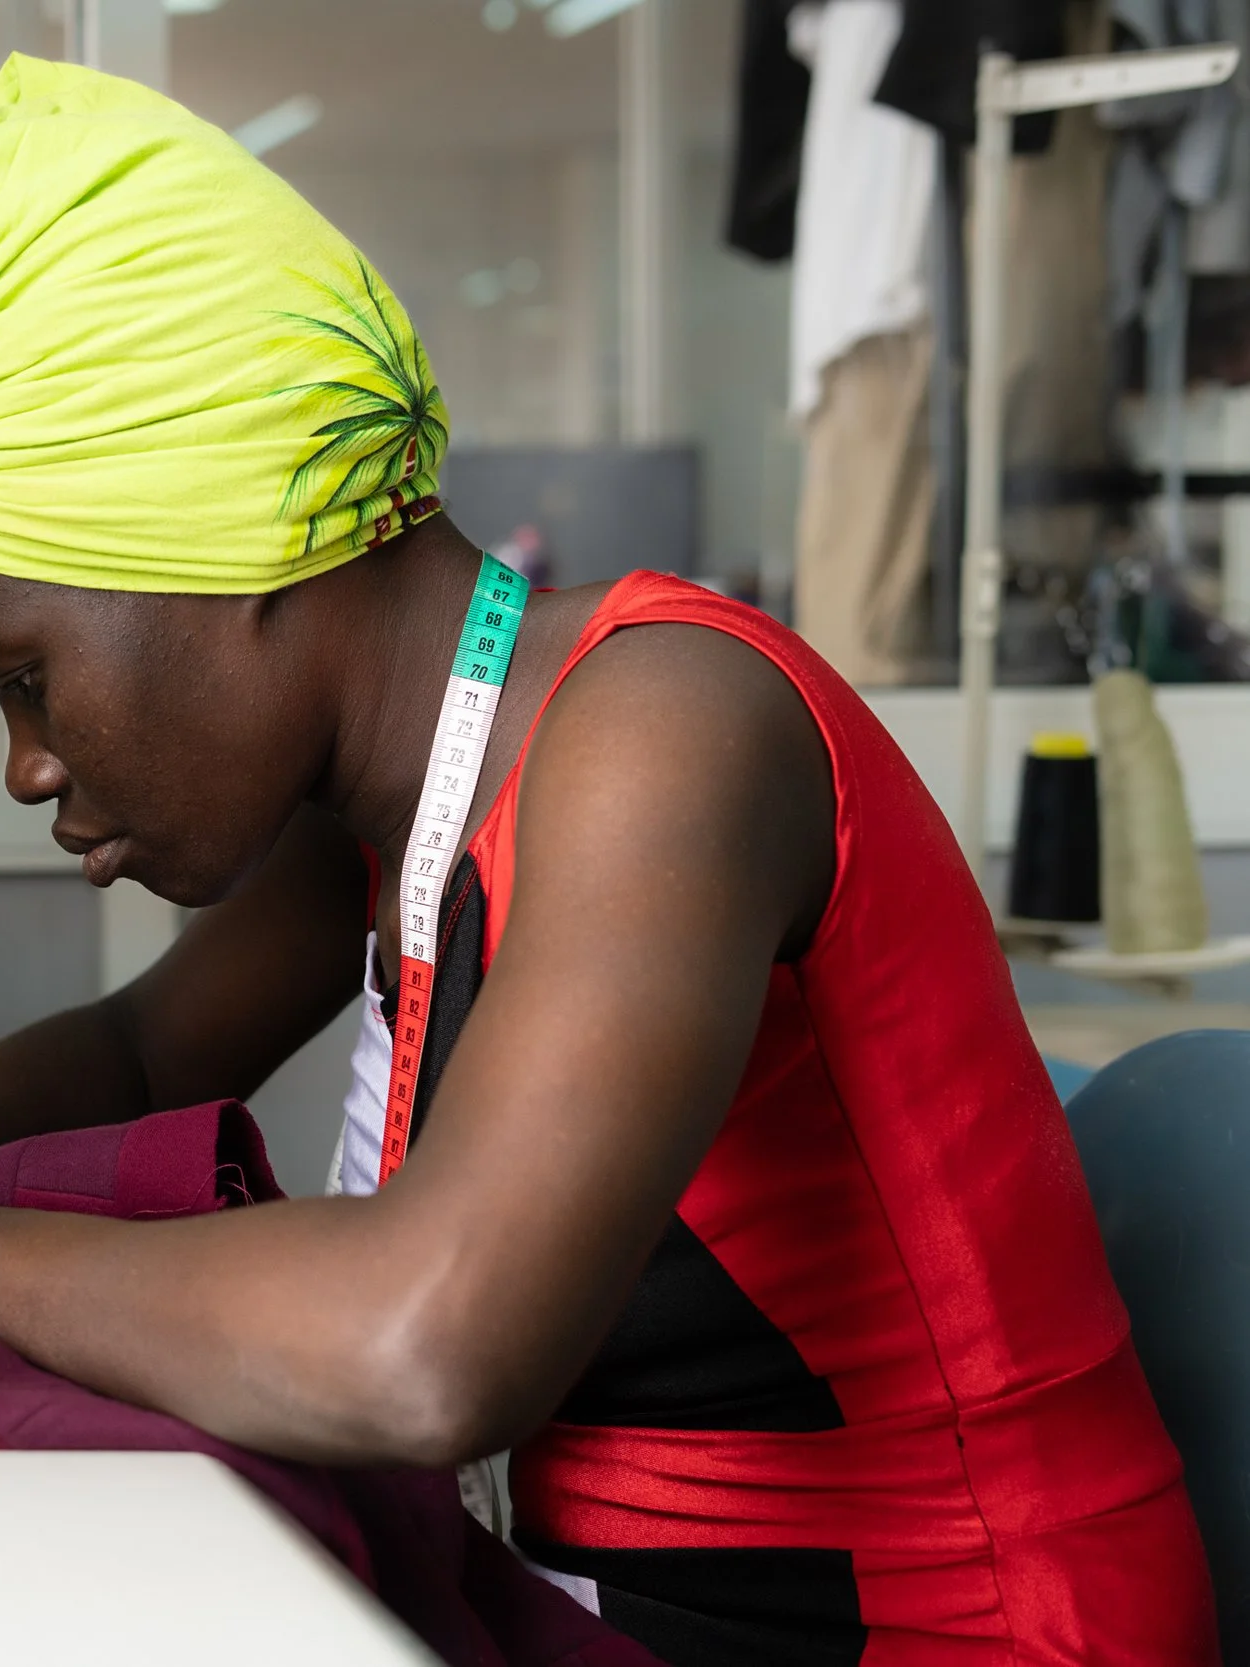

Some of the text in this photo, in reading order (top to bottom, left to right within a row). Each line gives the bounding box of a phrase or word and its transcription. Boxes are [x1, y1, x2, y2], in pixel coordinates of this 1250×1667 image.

[492, 589, 510, 602] 67
[485, 611, 503, 626] 68
[478, 637, 495, 652] 69
[470, 663, 488, 680] 70
[464, 691, 479, 708] 71
[450, 747, 466, 764] 73
[443, 775, 459, 792] 74
[427, 831, 442, 846] 76
[419, 857, 434, 873] 77
[412, 943, 424, 958] 80
[411, 971, 421, 987] 81
[409, 999, 420, 1015] 82
[405, 1027, 416, 1043] 83
[401, 1055, 411, 1071] 84
